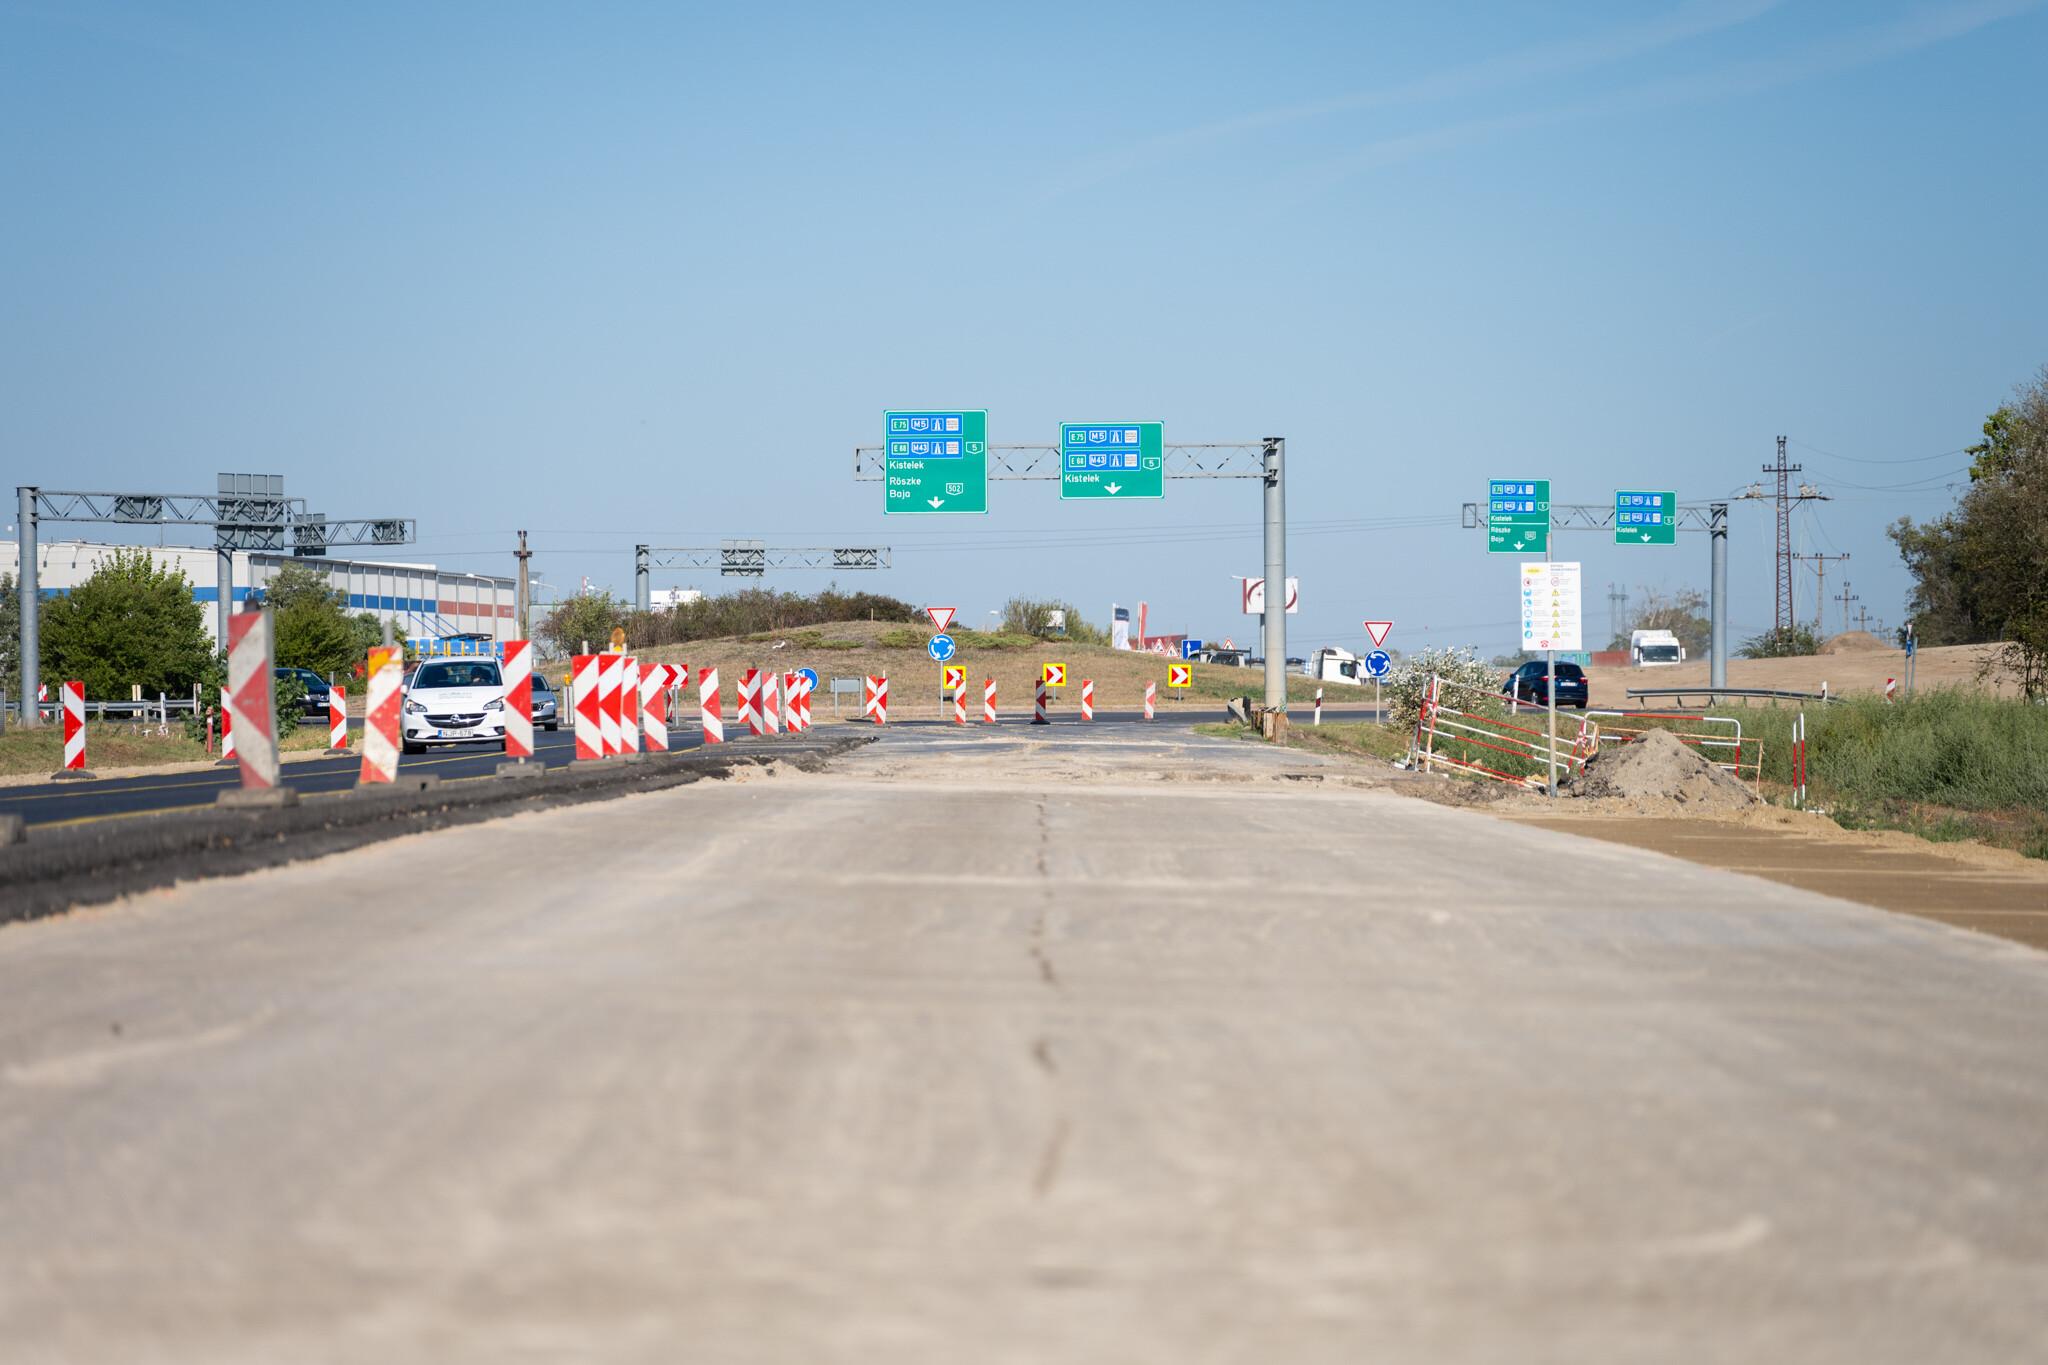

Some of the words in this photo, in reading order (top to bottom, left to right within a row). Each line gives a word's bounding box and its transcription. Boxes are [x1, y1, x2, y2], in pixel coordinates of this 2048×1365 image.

[889, 460, 925, 469] Kistelek
[889, 476, 922, 486] Röszke
[1065, 473, 1100, 483] Kistelek
[889, 489, 911, 500] Baja
